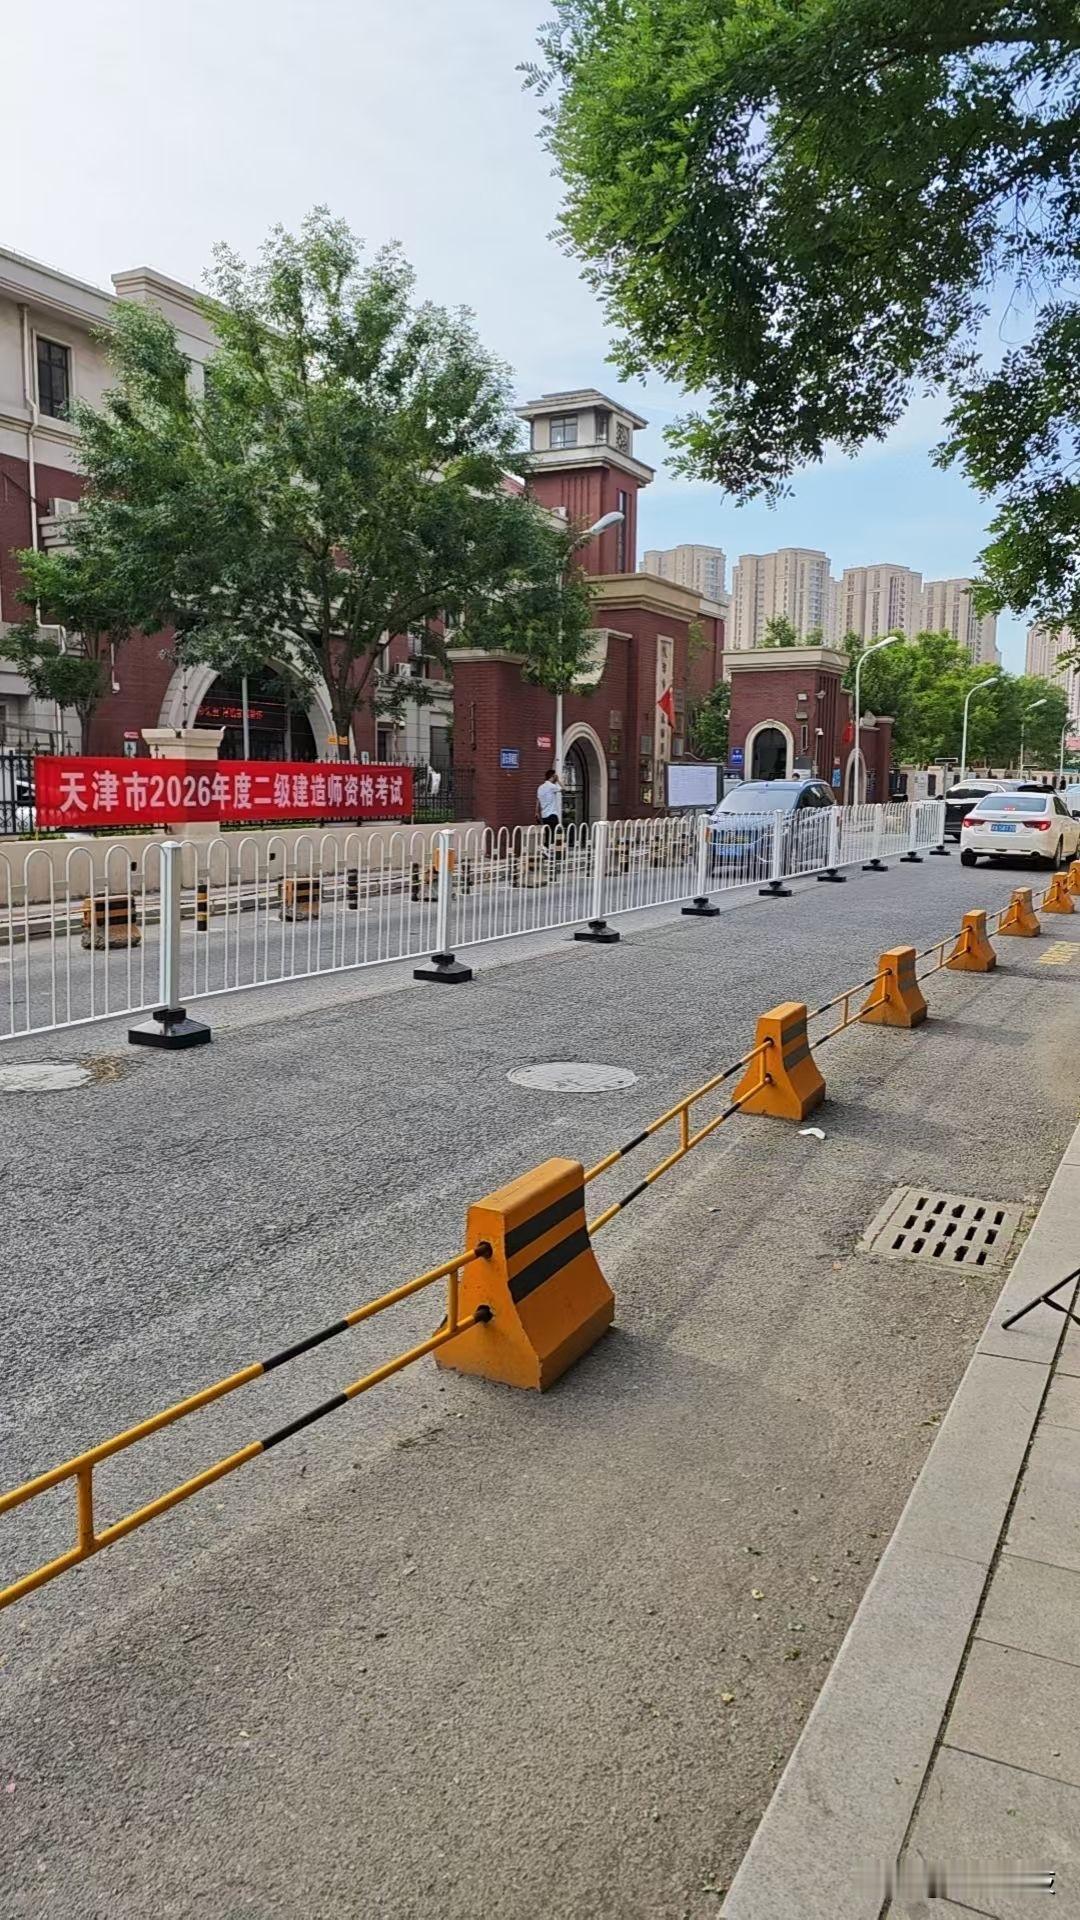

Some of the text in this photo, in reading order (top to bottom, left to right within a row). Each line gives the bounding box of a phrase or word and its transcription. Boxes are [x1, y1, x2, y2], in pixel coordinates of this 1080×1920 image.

[59, 770, 404, 812] 天津市2026年度二级建造师资格考试
